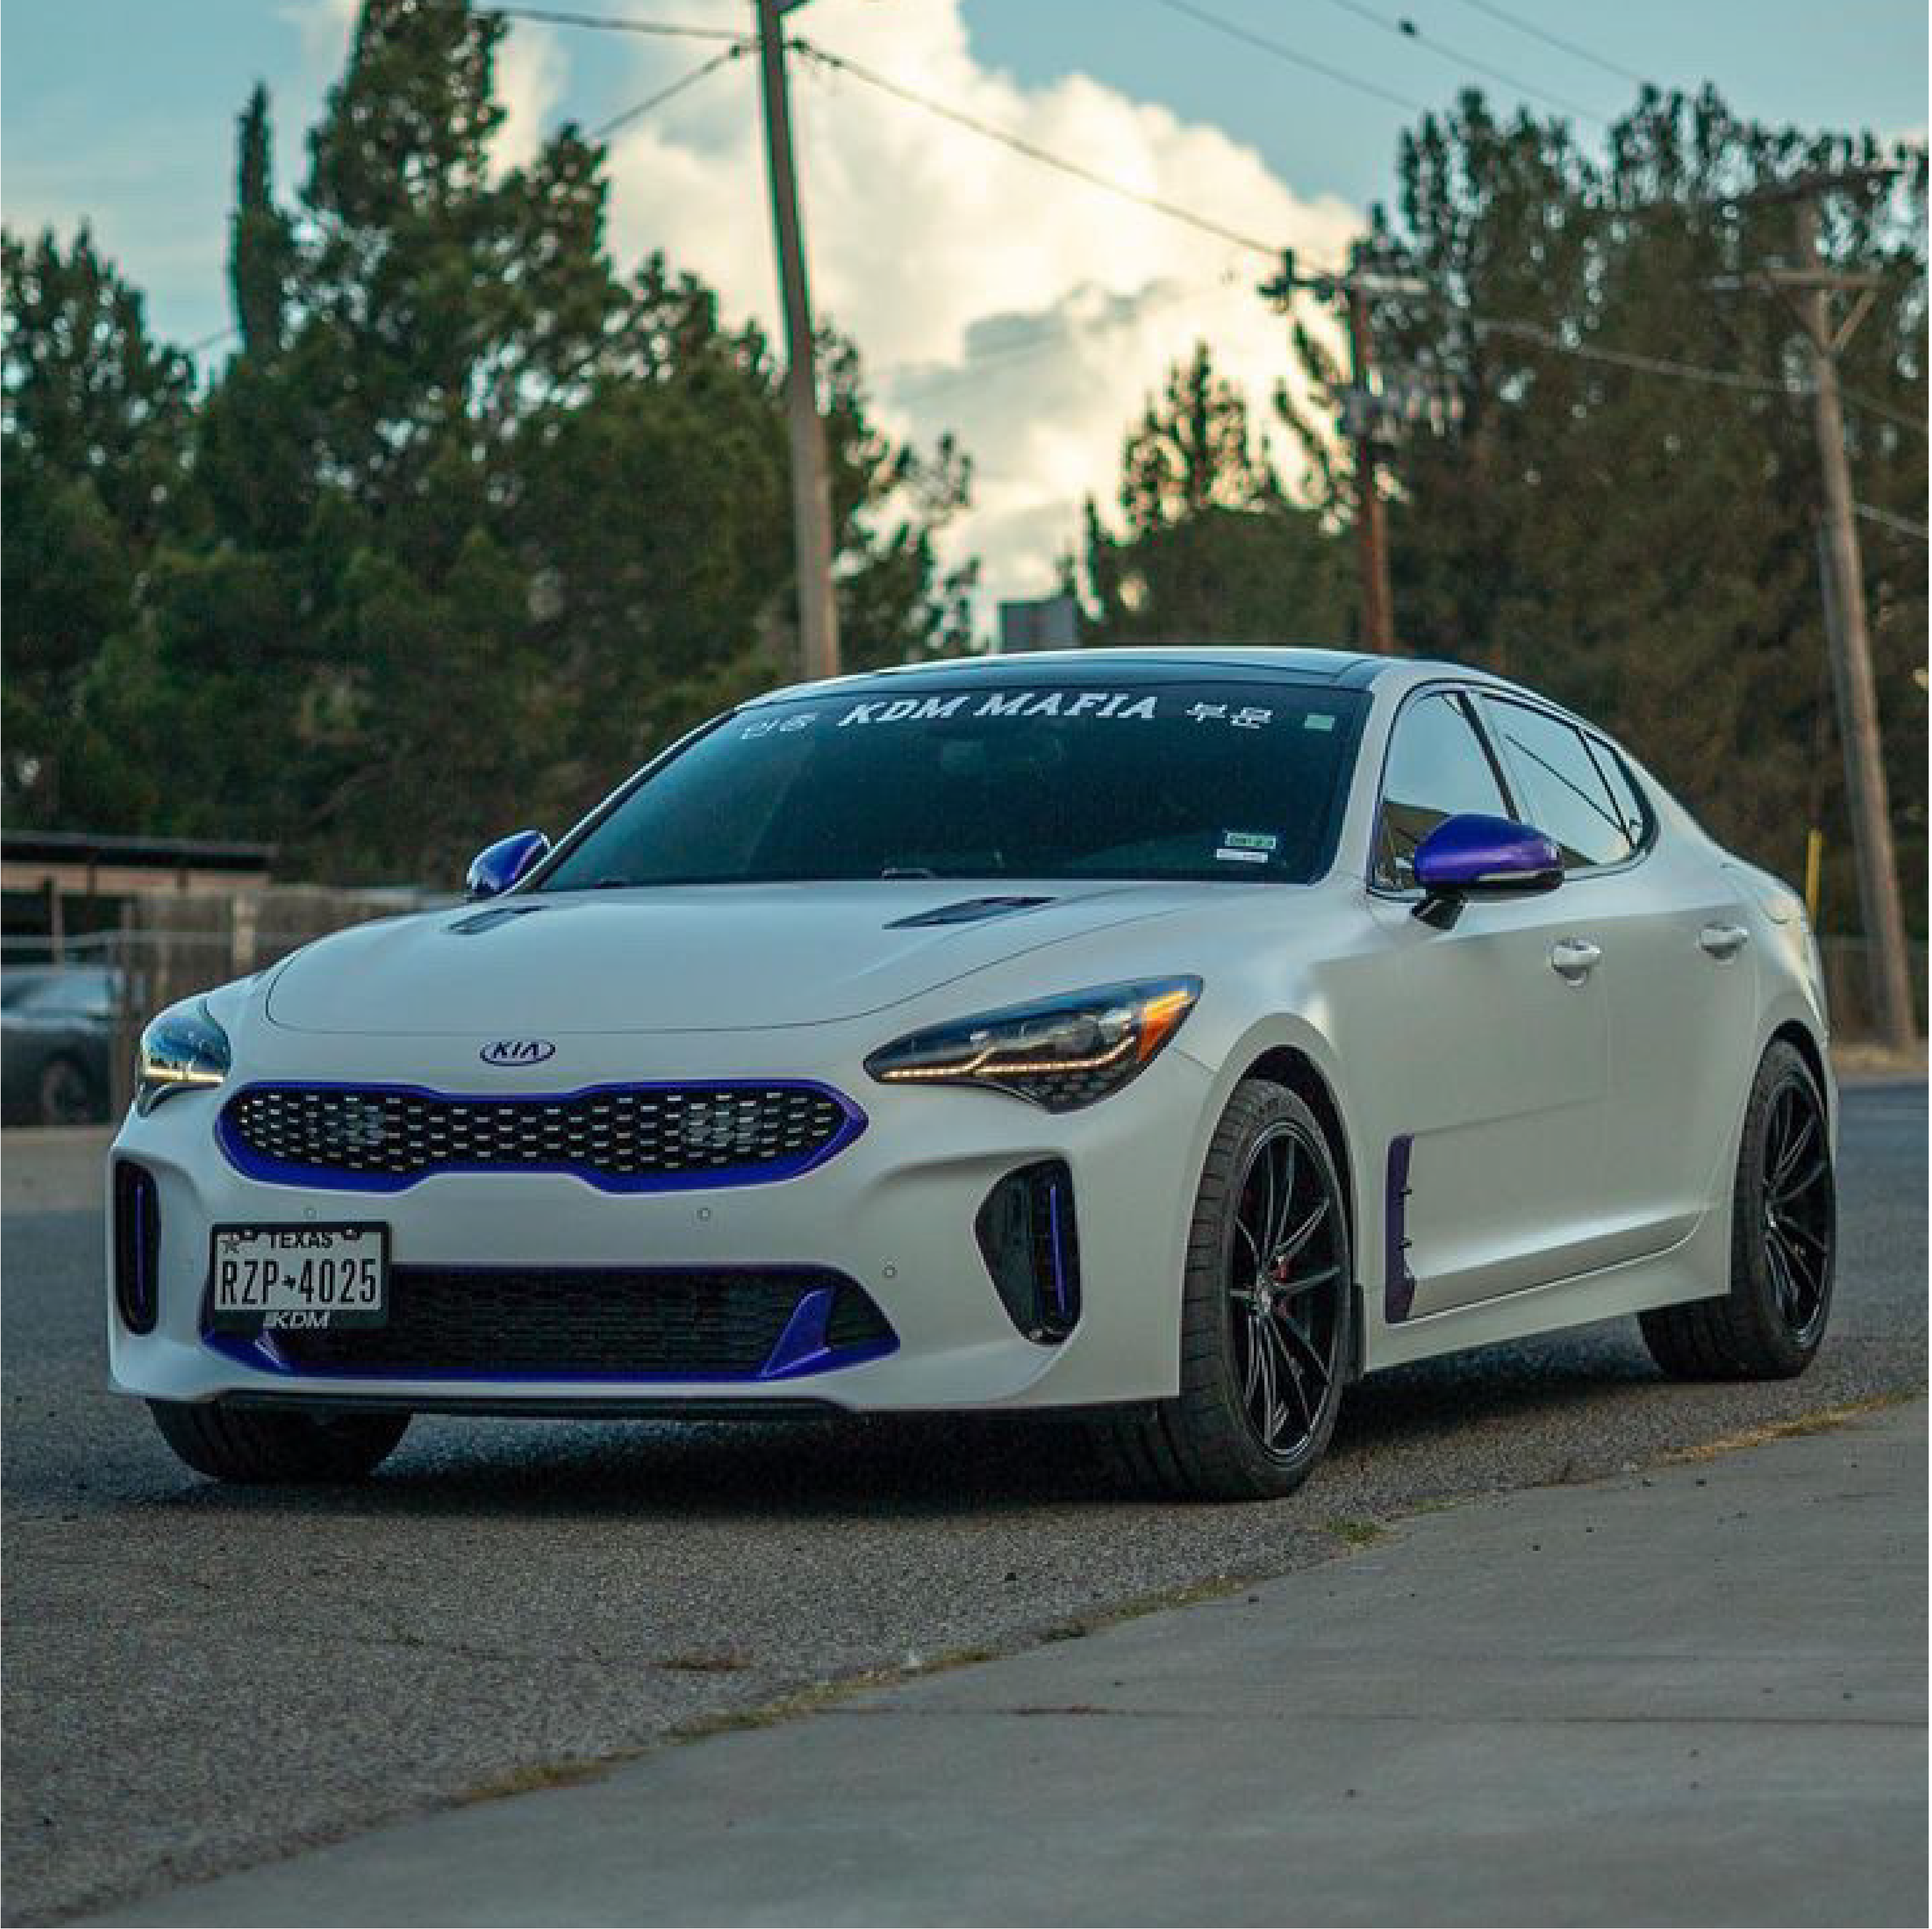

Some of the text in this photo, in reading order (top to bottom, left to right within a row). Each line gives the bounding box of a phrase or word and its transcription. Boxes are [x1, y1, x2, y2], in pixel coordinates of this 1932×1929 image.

[837, 696, 970, 726] KDM
[973, 693, 1157, 720] MAFIA
[493, 1041, 539, 1059] KIA
[270, 1232, 333, 1249] TEXAS
